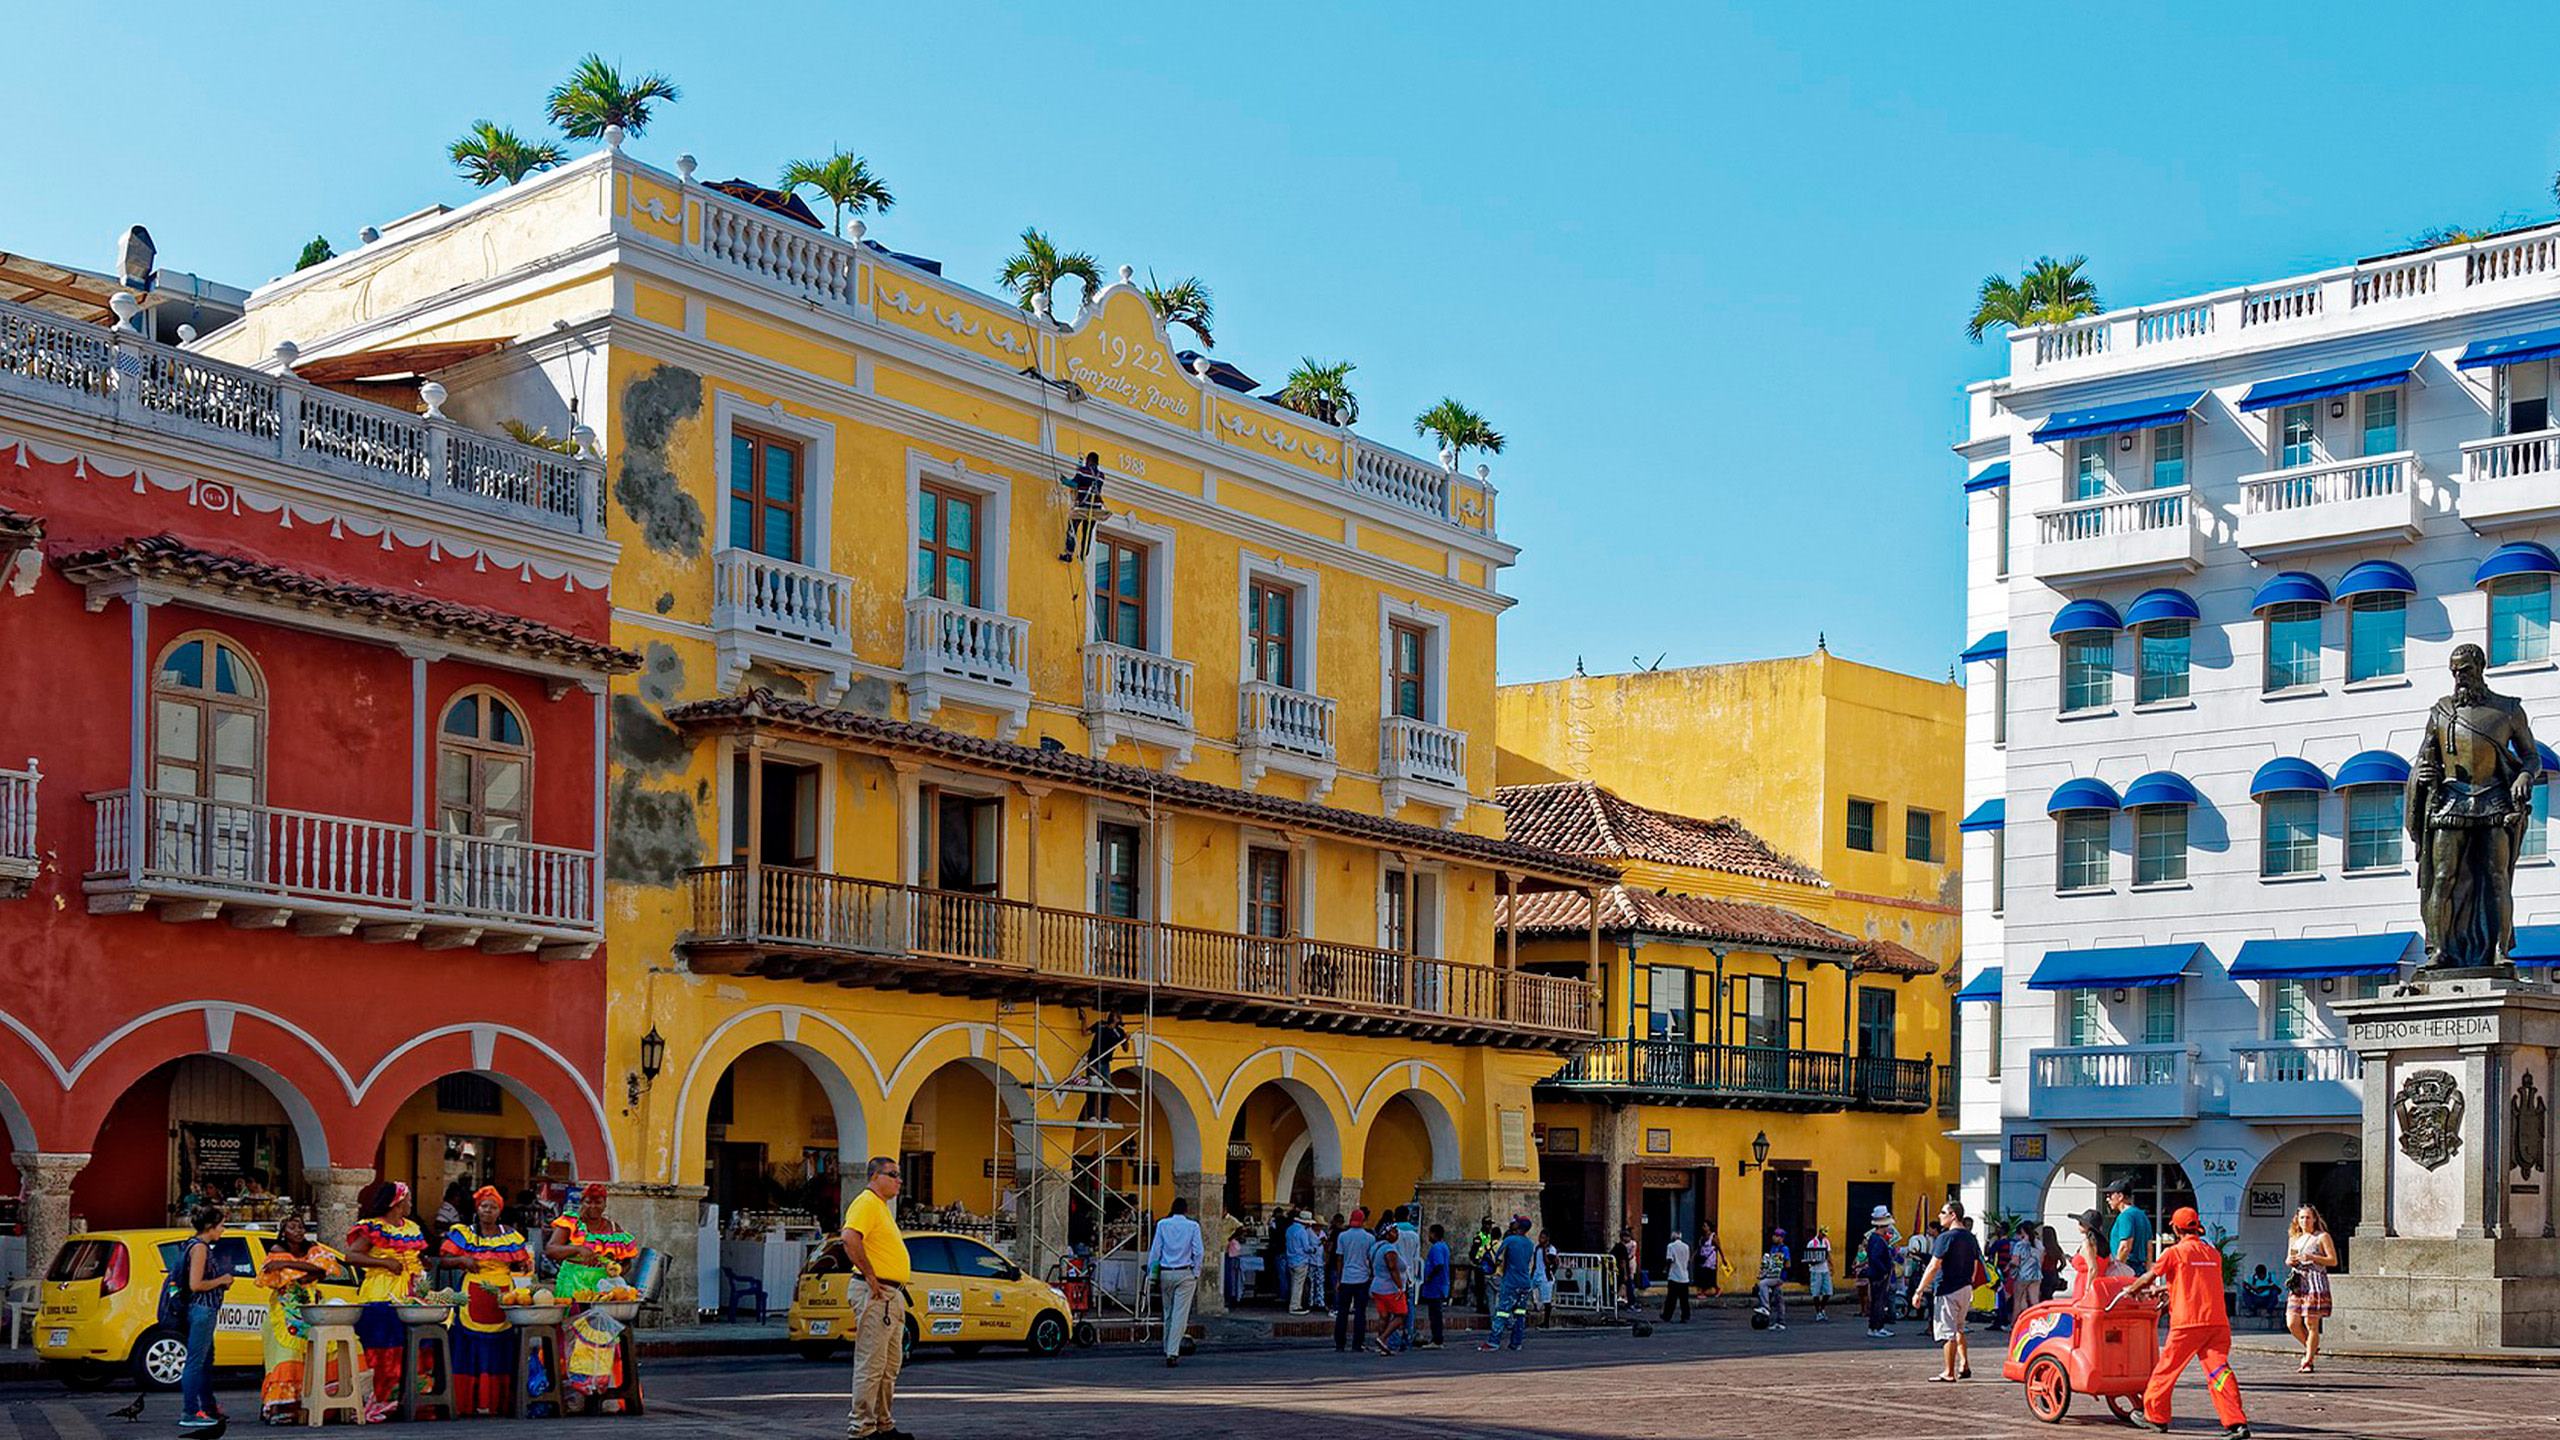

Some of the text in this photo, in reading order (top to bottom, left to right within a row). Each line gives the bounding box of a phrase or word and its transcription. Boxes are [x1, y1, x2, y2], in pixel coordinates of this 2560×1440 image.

[1098, 330, 1167, 377] 1922
[2354, 1018, 2492, 1040] PEDRO DE HEREDIA
[199, 1138, 241, 1149] $10.000
